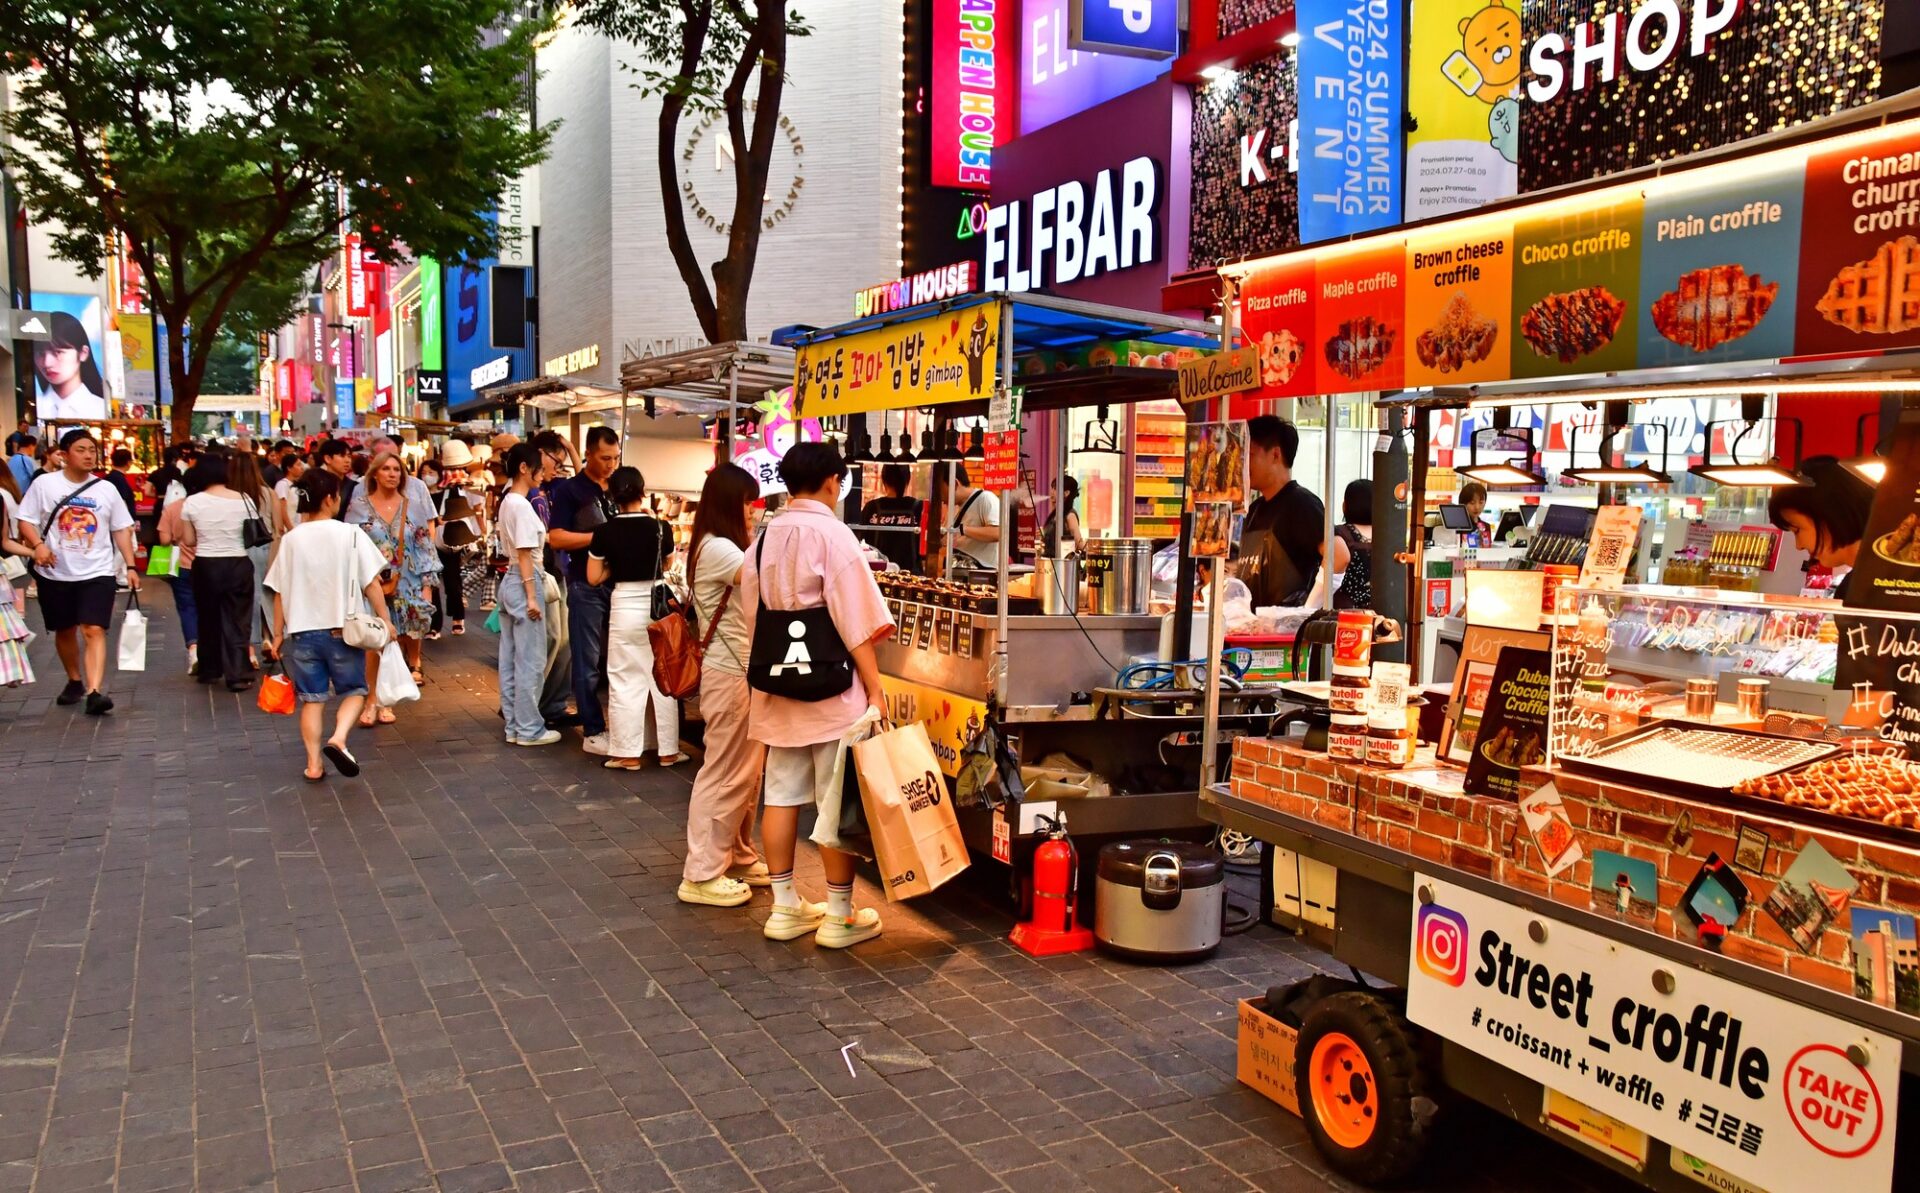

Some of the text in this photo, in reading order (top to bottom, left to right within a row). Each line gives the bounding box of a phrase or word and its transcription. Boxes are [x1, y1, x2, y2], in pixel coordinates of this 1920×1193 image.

[1527, 0, 1738, 102] SHOP
[1343, 0, 1365, 216] YEONGDONG
[959, 92, 994, 184] HOUSE
[1366, 70, 1391, 216] SUMMER
[1419, 197, 1440, 206] Enjoy
[1852, 174, 1920, 209] churr
[985, 156, 1155, 293] ELFBAR
[1657, 201, 1782, 242] Plain croffle
[1854, 199, 1920, 234] croff
[1414, 239, 1504, 270] Brown cheese
[1521, 228, 1631, 265] Choco croffle
[855, 260, 970, 318] BUTTON HOUSE
[1323, 271, 1398, 300] Maple croffle
[1434, 264, 1480, 288] croffle
[1247, 288, 1307, 312] Pizza croffle
[849, 351, 883, 390] 꼬마
[886, 331, 925, 391] 김밥
[925, 361, 963, 391] gimbap
[1180, 359, 1254, 399] Welcome
[1086, 559, 1110, 569] oney
[1089, 575, 1100, 584] ox
[1896, 661, 1920, 683] Ch
[1330, 689, 1364, 700] nutella
[1500, 680, 1549, 701] Chocola
[1505, 697, 1549, 716] Croffle
[1329, 736, 1400, 751] nutella nutella
[901, 778, 926, 801] SHOE
[909, 796, 931, 814] MARKER
[1473, 929, 1771, 1101] Street_croffle
[1471, 1007, 1482, 1027] #
[1486, 1013, 1573, 1074] croissant
[1577, 1057, 1590, 1076] +
[1596, 1063, 1666, 1112] waffle
[1797, 1064, 1871, 1113] TAKE
[1800, 1096, 1864, 1139] OUT
